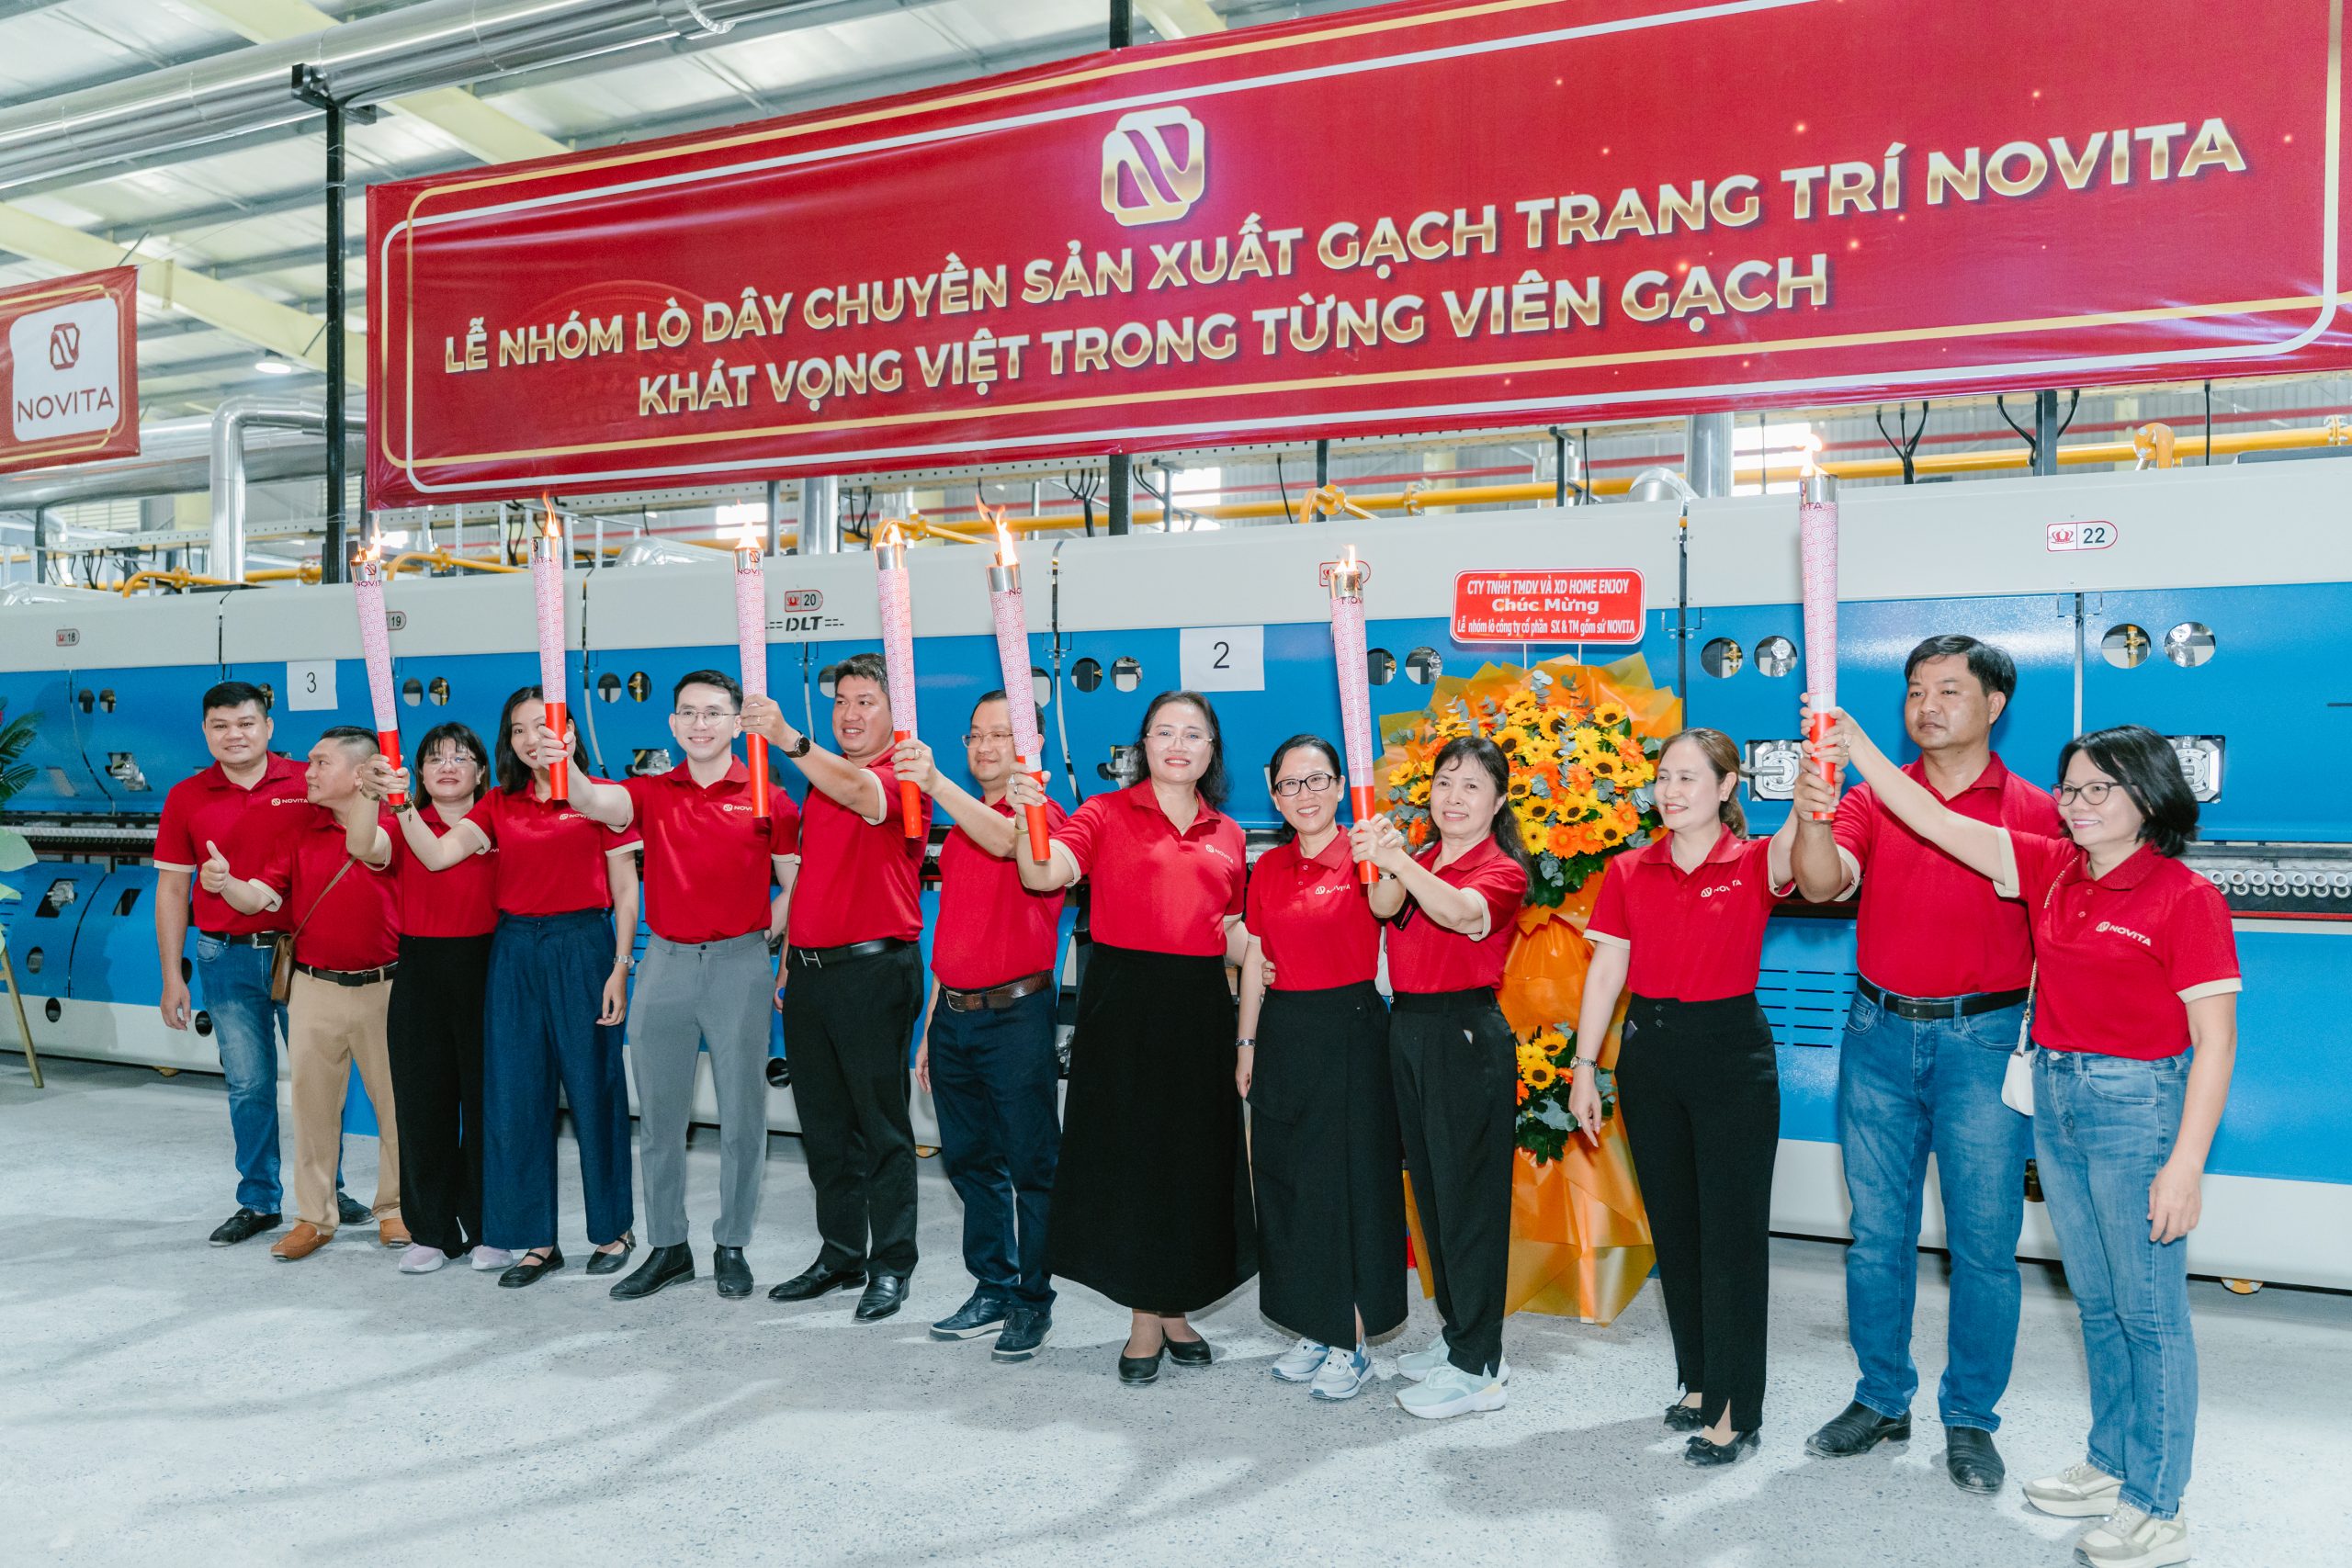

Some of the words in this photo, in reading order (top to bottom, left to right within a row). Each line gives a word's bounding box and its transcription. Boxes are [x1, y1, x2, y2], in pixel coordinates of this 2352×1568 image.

[445, 317, 489, 374] LỄ
[498, 310, 625, 367] NHÓM
[636, 297, 692, 351] LÒ
[702, 287, 794, 344] DÂY
[803, 252, 1008, 330] CHUYỀN
[1021, 240, 1133, 304] SẢN
[1148, 212, 1304, 290] XUẤT
[1317, 204, 1497, 279] GẠCH
[1515, 175, 1760, 249] TRANG
[1781, 141, 1907, 220] TRÍ
[1927, 117, 2247, 206] NOVITA
[639, 359, 757, 416] KHÁT
[765, 349, 903, 412] VỌNG
[915, 328, 1030, 396] VIỆT
[1041, 312, 1238, 377] TRONG
[1251, 292, 1425, 356] TỪNG
[1441, 268, 1601, 339] VIÊN
[1621, 253, 1827, 333] GẠCH
[17, 386, 115, 423] NOVITA
[2083, 527, 2106, 544] 22
[1466, 580, 1486, 595] CTY
[1486, 580, 1511, 595] TNHH
[1540, 574, 1553, 594] VÀ
[1554, 579, 1567, 594] XD
[1568, 579, 1598, 594] HOME
[1598, 578, 1630, 594] ENJOY
[803, 593, 818, 606] 20
[1491, 596, 1540, 613] Chúc
[1544, 596, 1600, 615] Mừng
[390, 615, 402, 626] 19
[786, 615, 824, 632] DLT
[1468, 617, 1487, 633] nhóm
[1495, 617, 1513, 637] công
[1513, 620, 1521, 637] ty
[1551, 619, 1561, 634] SX
[1561, 619, 1568, 634] &
[1568, 619, 1580, 634] TM
[1607, 619, 1635, 634] NOVITA
[1213, 641, 1230, 670] 2
[306, 671, 317, 694] 3
[2109, 924, 2152, 947] NOVITA
